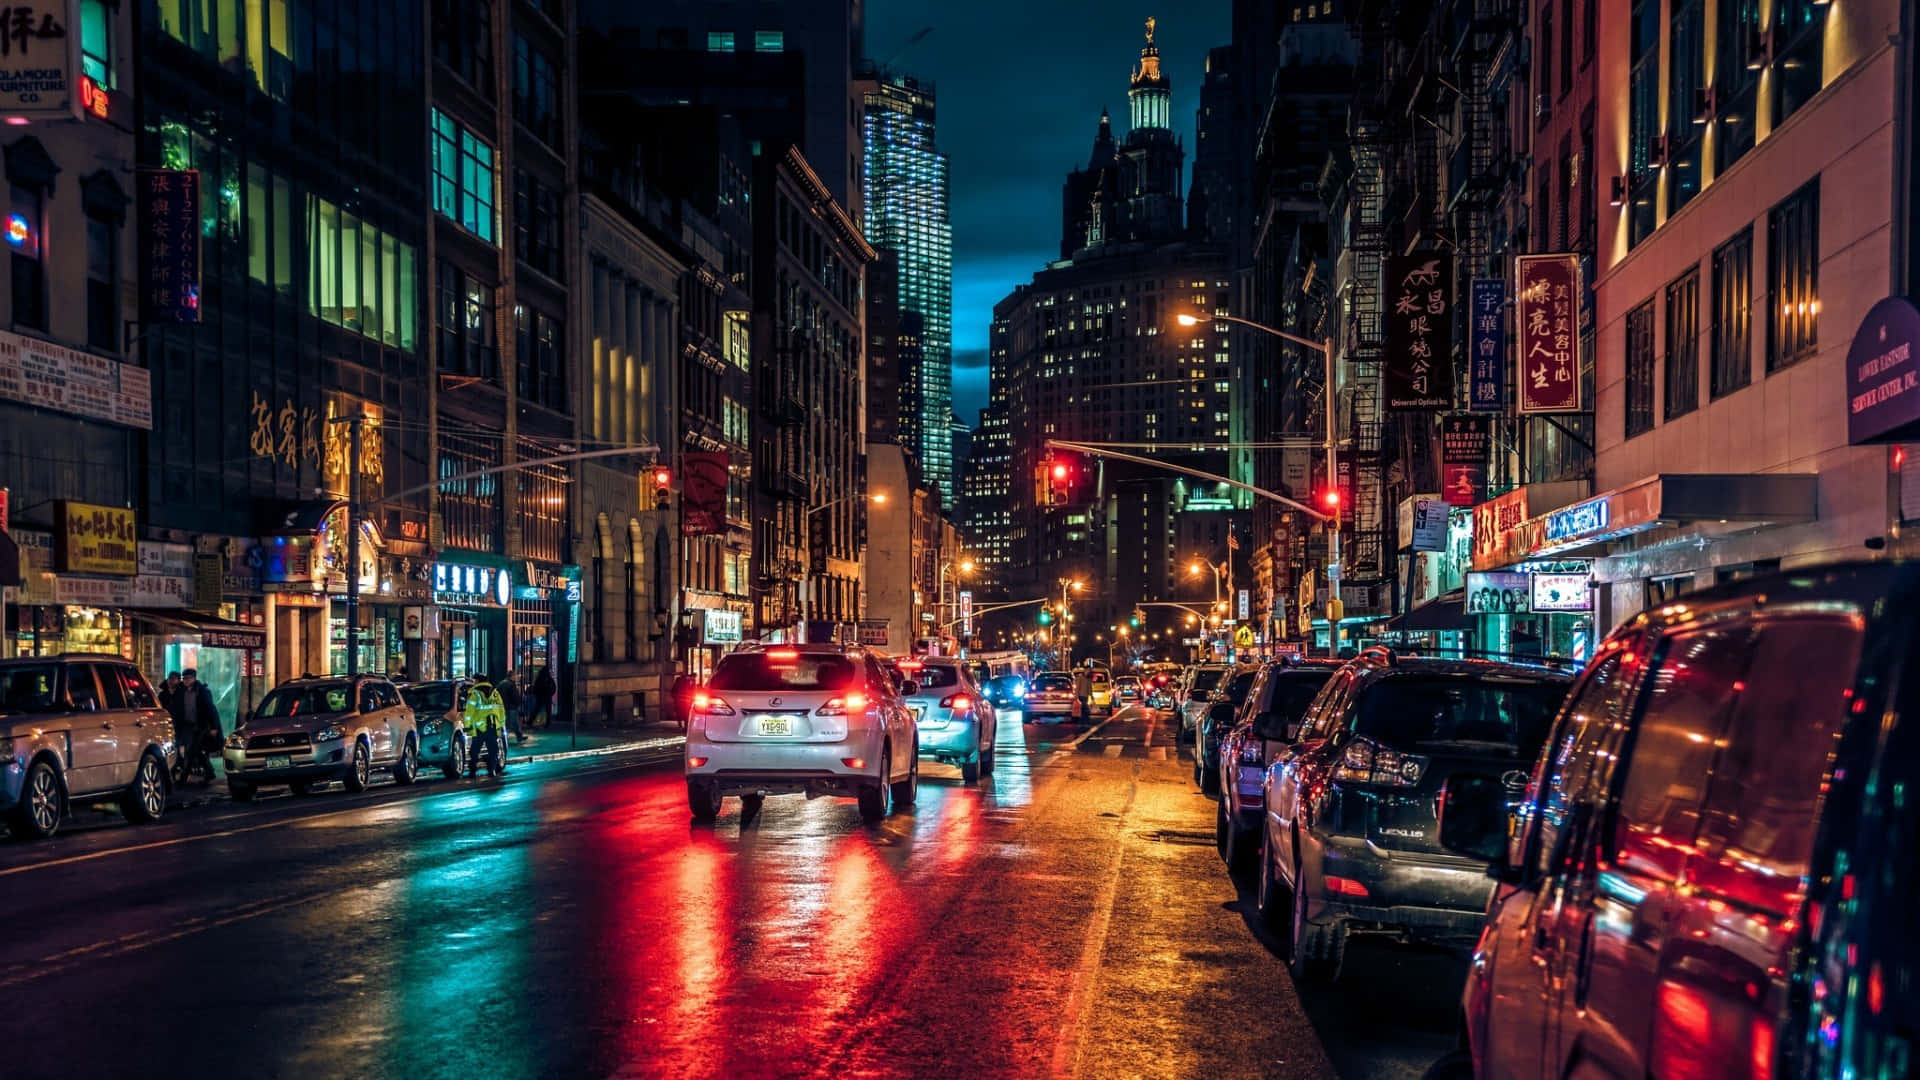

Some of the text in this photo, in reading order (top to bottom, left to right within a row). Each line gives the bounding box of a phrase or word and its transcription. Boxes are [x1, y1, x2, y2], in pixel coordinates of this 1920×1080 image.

[0, 79, 66, 92] URNITURE
[1527, 279, 1555, 390] 漂亮人生
[1858, 358, 1879, 383] LOWER
[1378, 827, 1424, 838] LEXUS
